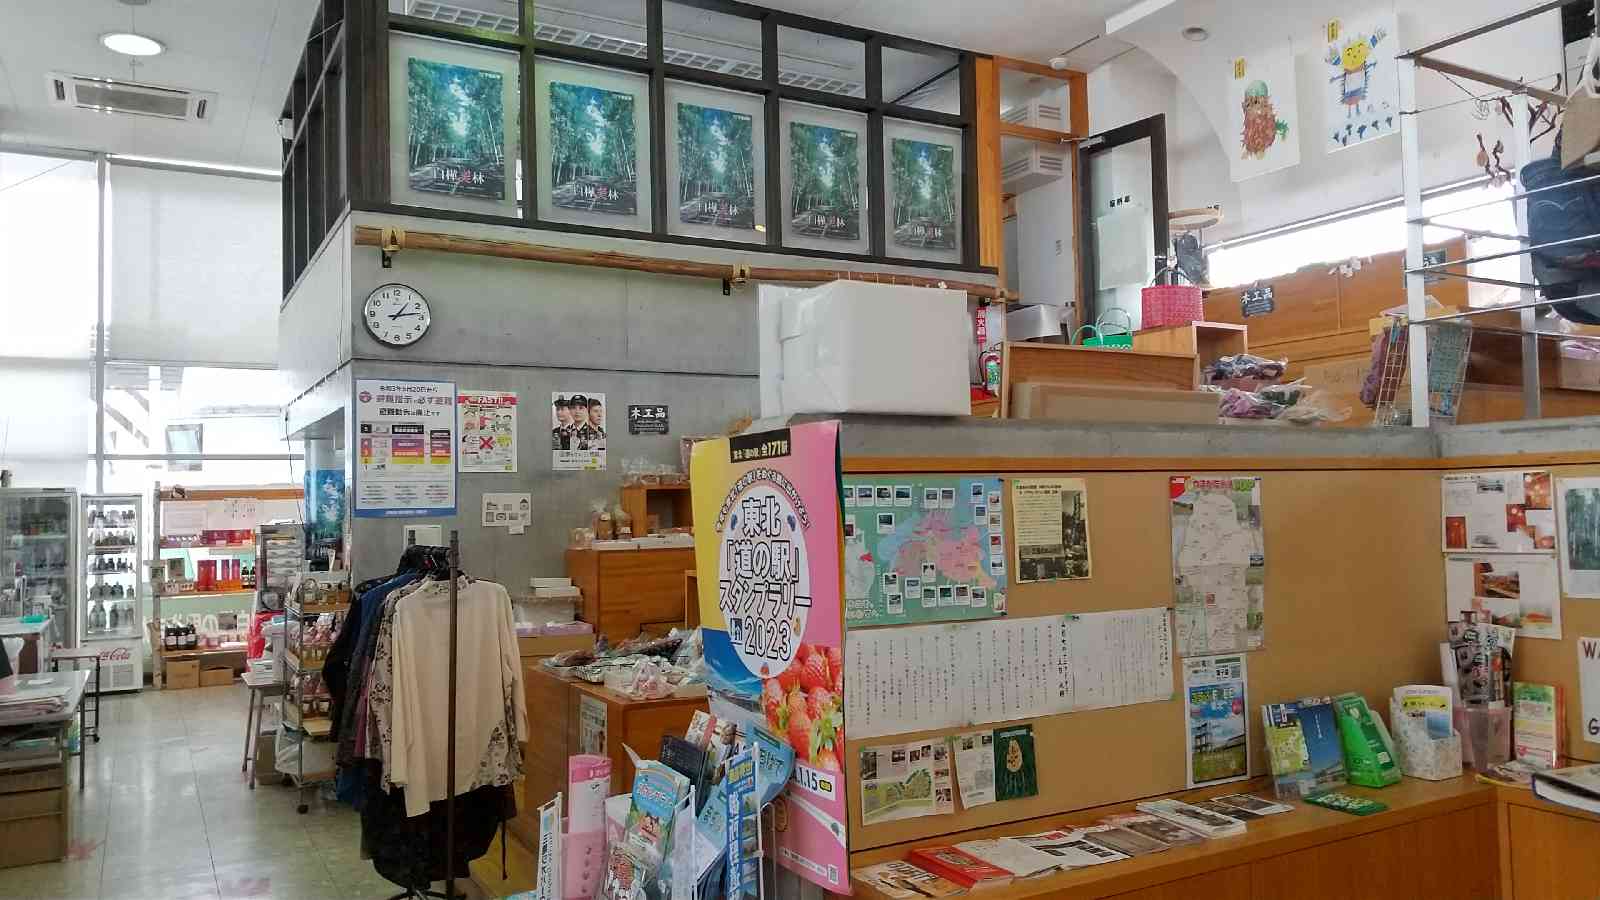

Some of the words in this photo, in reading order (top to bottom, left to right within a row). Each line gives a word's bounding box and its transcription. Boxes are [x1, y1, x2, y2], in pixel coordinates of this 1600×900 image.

[1240, 287, 1273, 305] 木工品
[631, 407, 666, 420] 木工品
[741, 495, 782, 538] 東北
[727, 539, 800, 583] 「道の駅」
[719, 578, 813, 620] スタンプラリー
[743, 616, 792, 662] 2023
